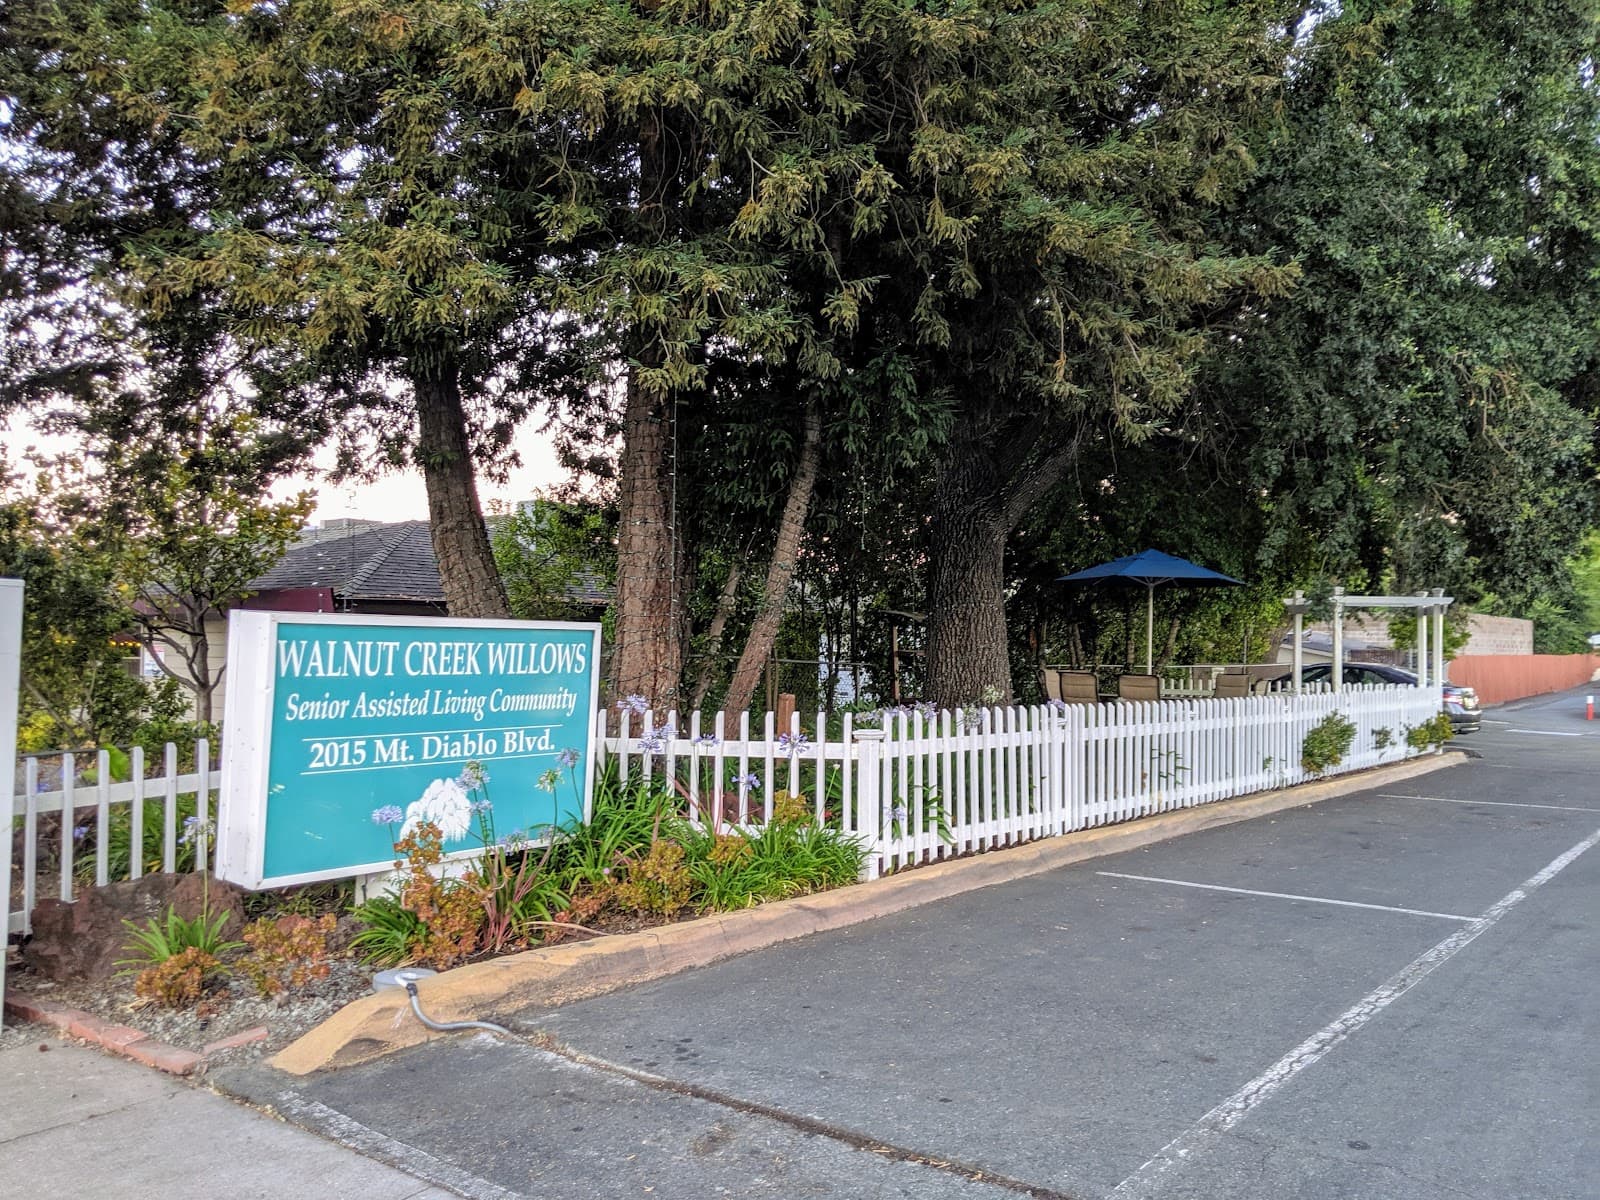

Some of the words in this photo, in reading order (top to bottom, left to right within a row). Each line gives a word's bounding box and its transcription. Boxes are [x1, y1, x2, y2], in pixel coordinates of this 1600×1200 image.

[279, 640, 399, 678] WALNUT
[404, 641, 484, 676] CREEK
[487, 643, 586, 675] WILLOWS
[285, 692, 349, 721] Senior
[352, 689, 431, 718] Assisted
[433, 688, 486, 721] Living
[489, 686, 577, 717] Community
[309, 740, 366, 768] 2015
[373, 739, 414, 764] Mt.
[422, 733, 496, 760] Diablo
[503, 728, 555, 754] Blvd.
